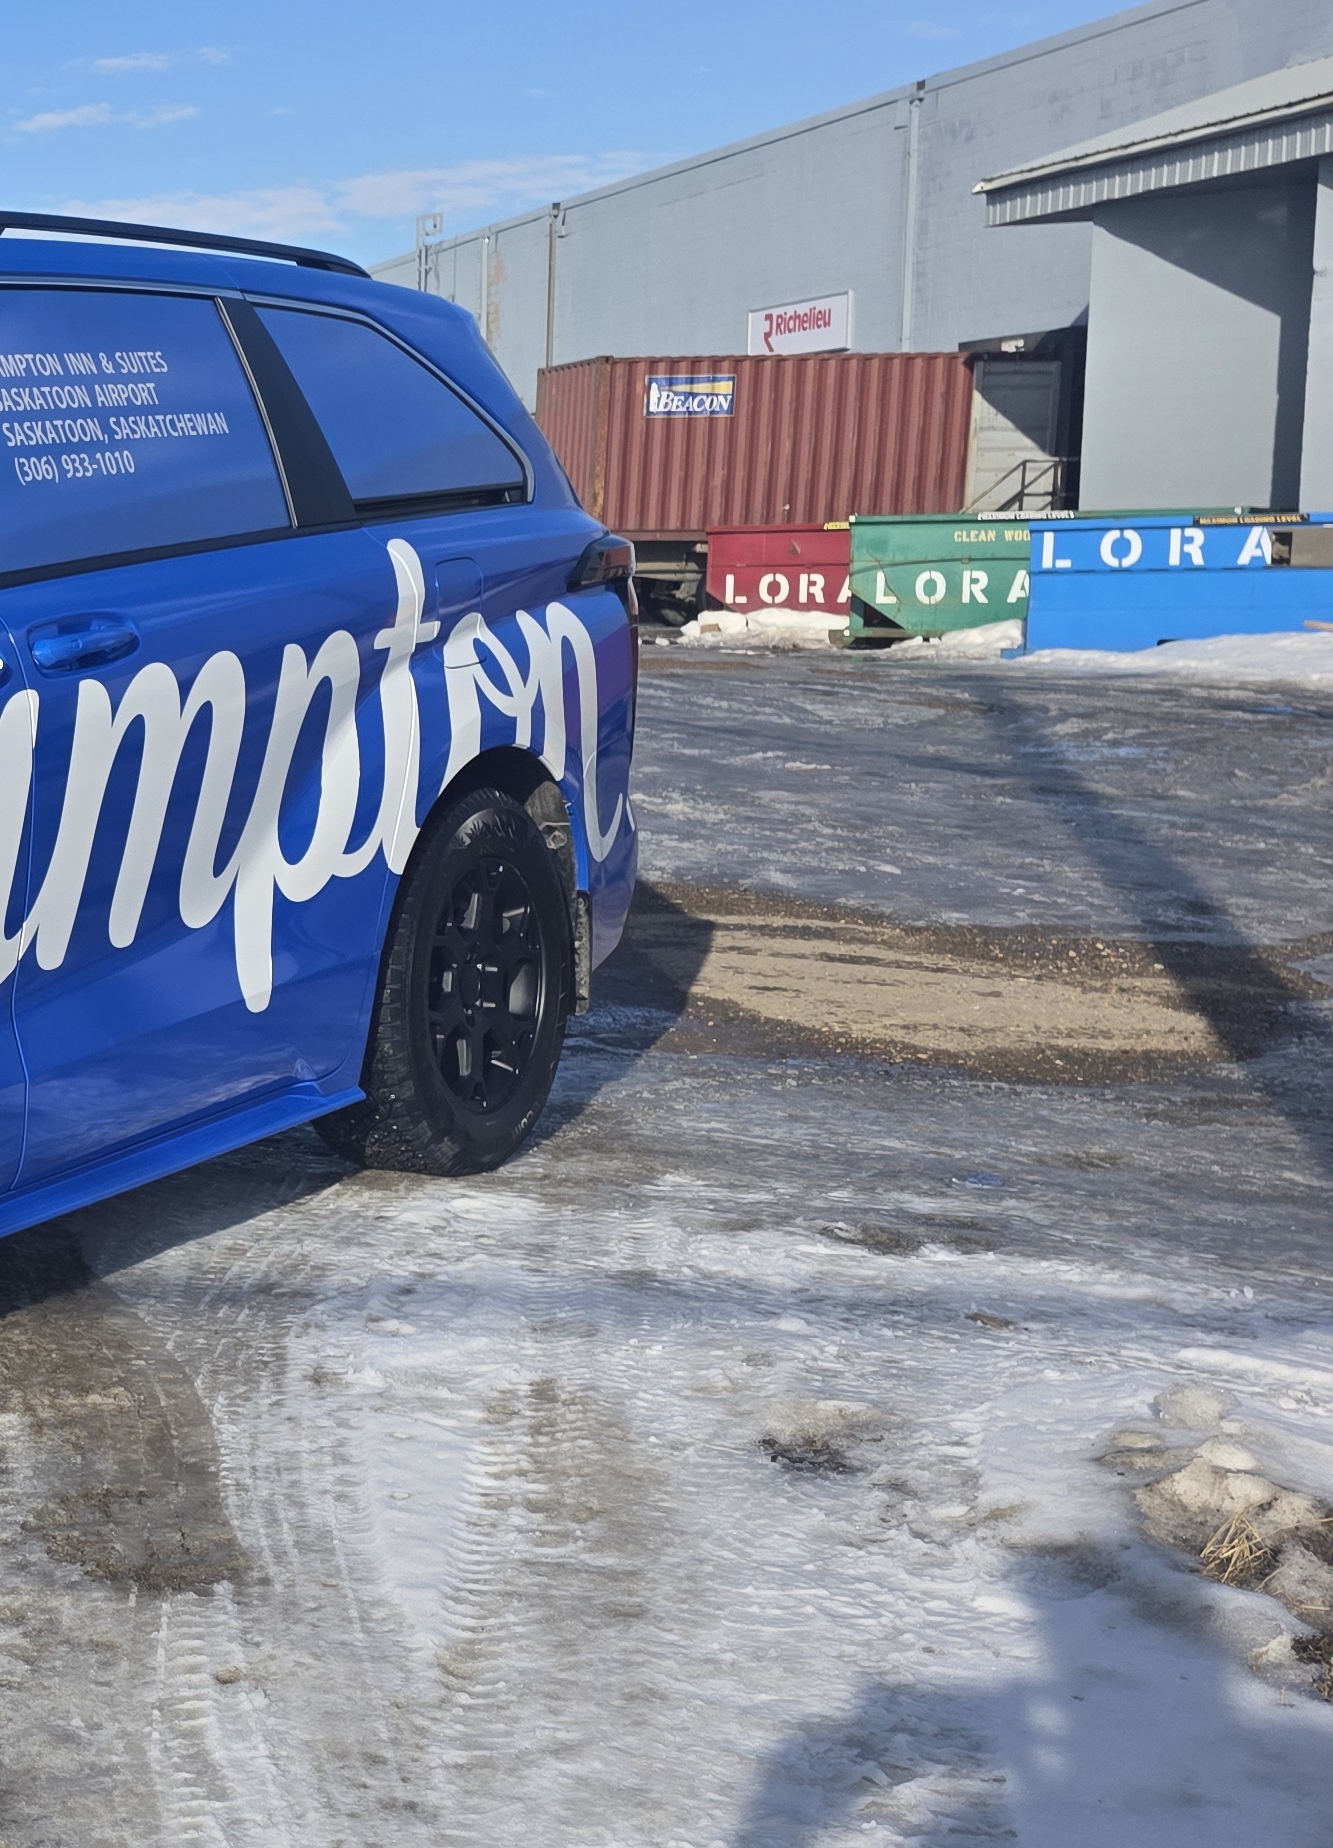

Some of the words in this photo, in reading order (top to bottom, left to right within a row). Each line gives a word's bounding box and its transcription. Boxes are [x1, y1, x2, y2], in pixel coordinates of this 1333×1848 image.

[775, 307, 832, 336] Richelieu
[65, 352, 97, 376] INN
[99, 352, 115, 375] &
[116, 350, 168, 374] SUITES
[95, 382, 160, 408] AIRPORT
[657, 390, 732, 412] BEACON
[1, 417, 110, 447] SASKATOON,
[109, 411, 229, 441] SASKATCHEWAN
[14, 455, 59, 486] (306)
[61, 449, 136, 479] 933-1010
[954, 530, 996, 543] CLEAN
